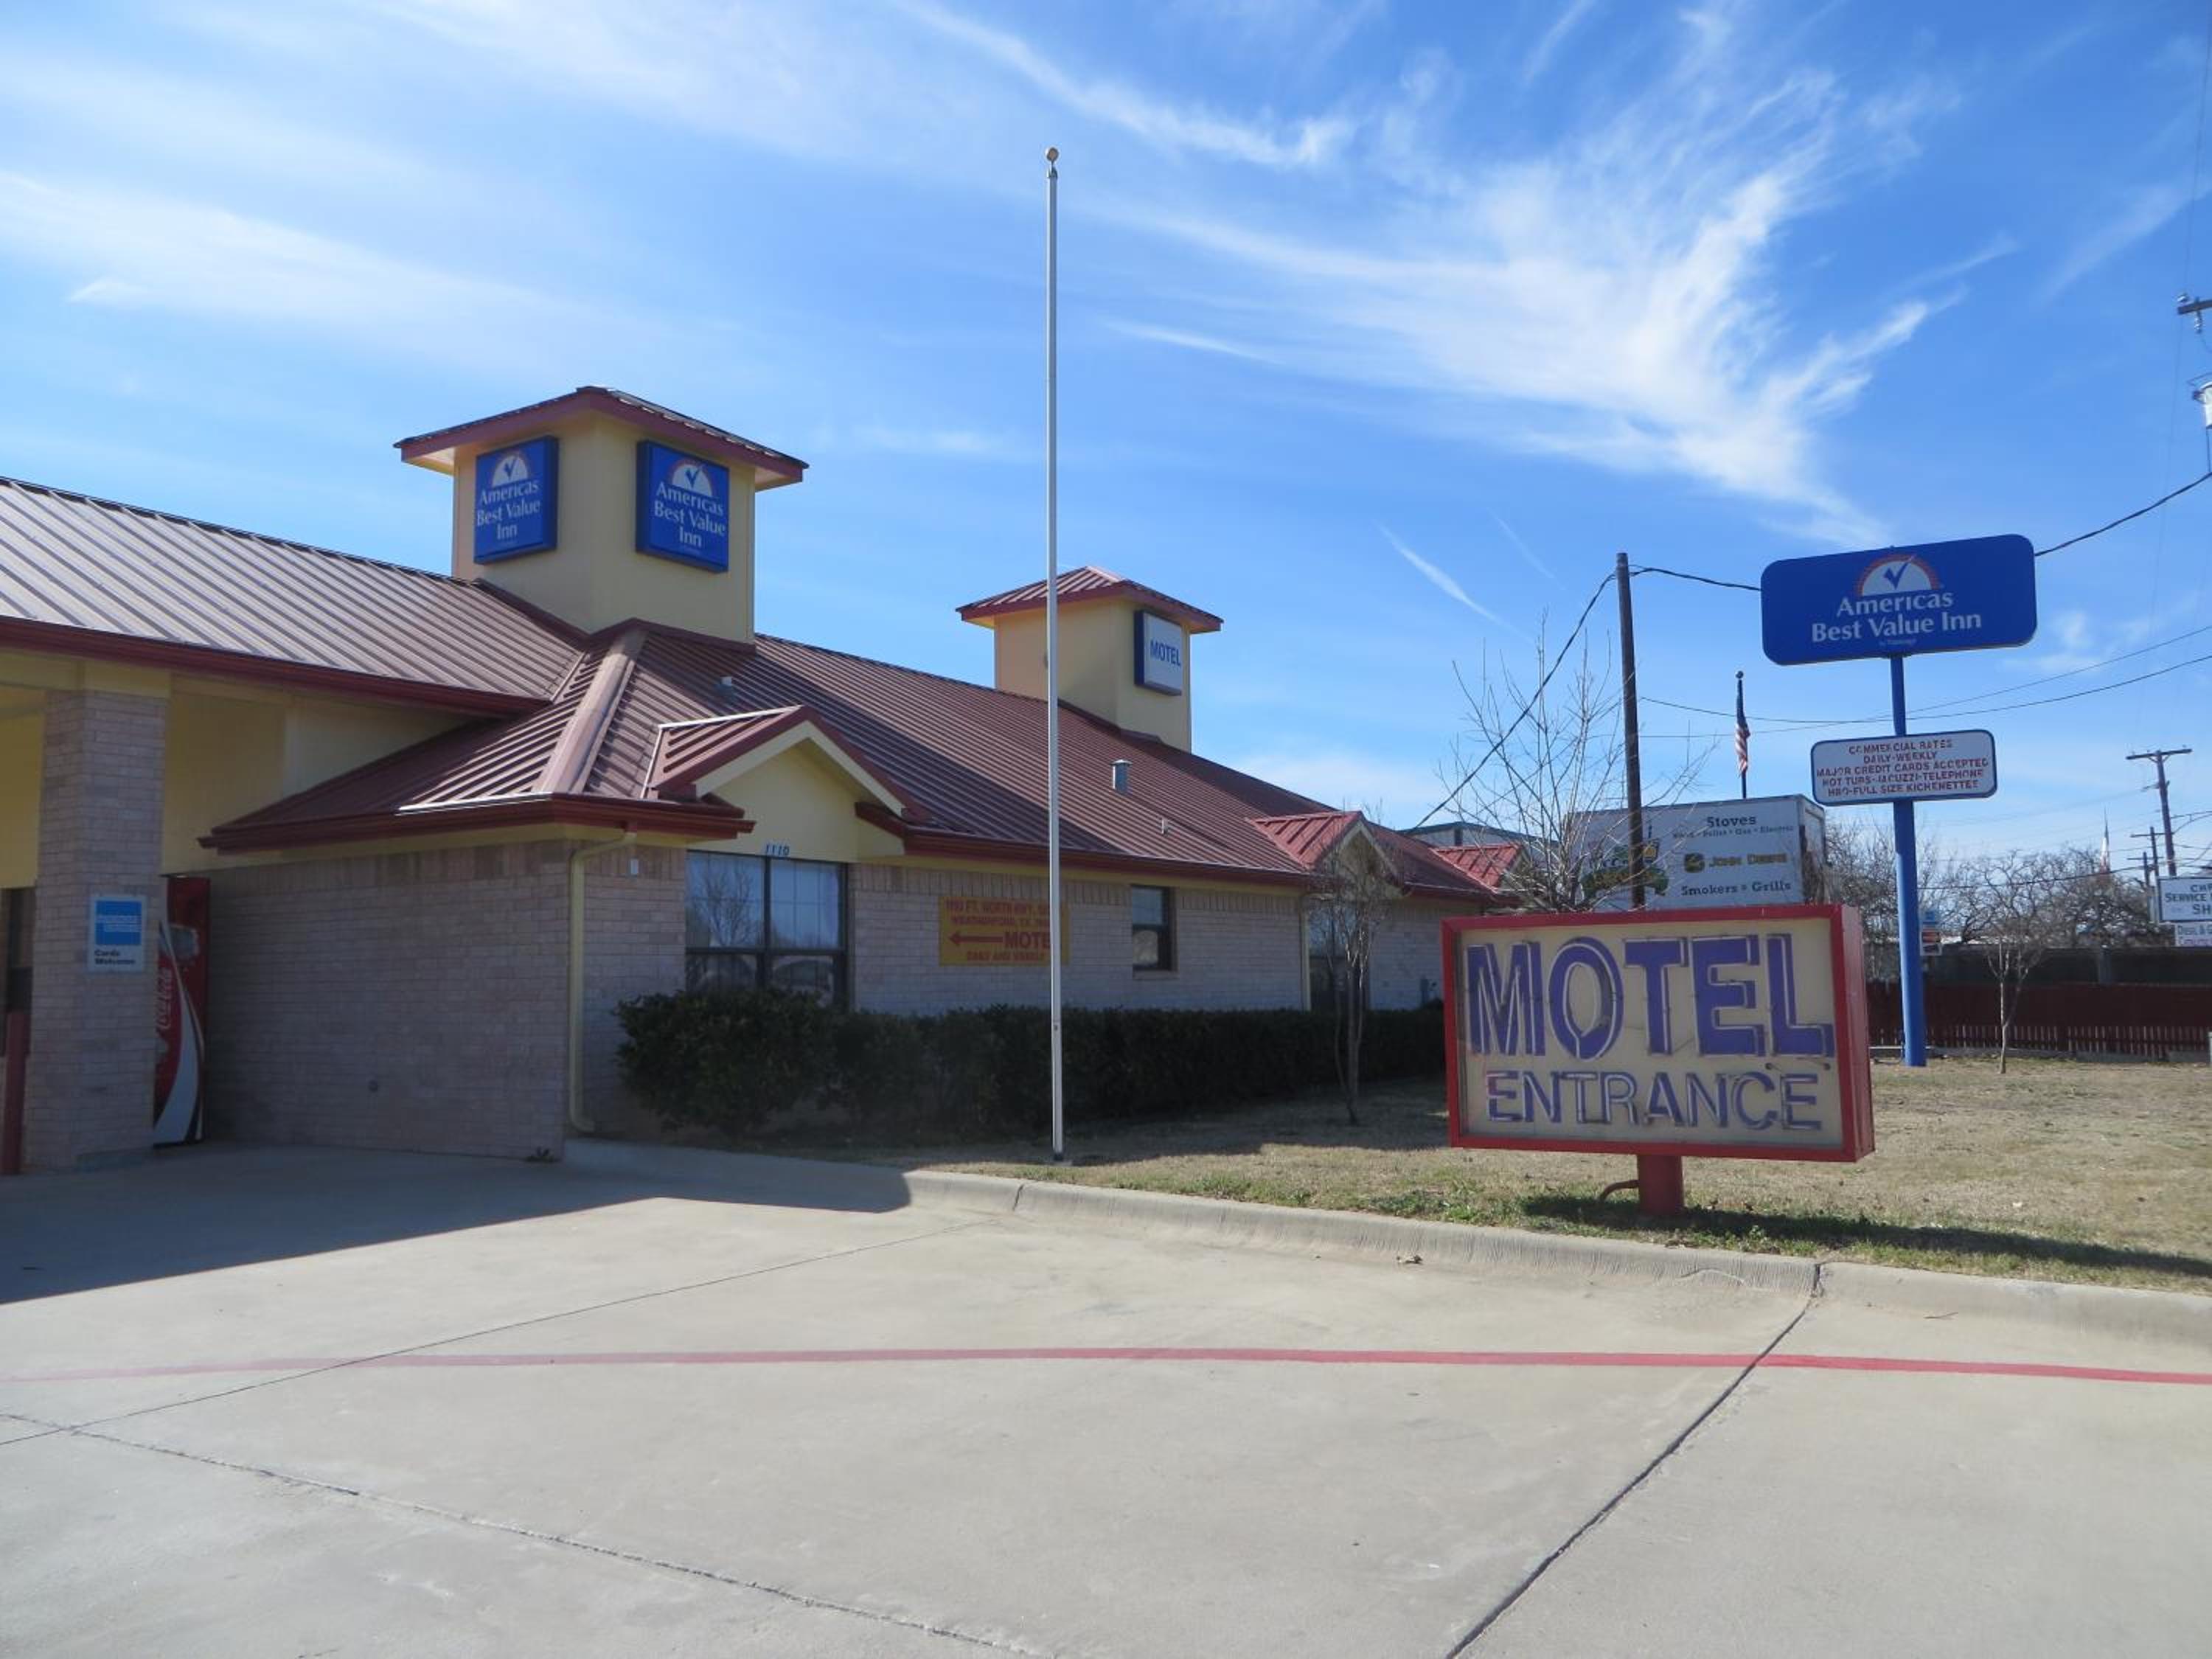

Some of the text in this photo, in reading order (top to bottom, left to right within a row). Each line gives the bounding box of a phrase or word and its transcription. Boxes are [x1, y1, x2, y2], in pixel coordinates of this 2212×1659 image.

[480, 479, 540, 506] Americas
[655, 482, 724, 516] Americas
[476, 498, 540, 527] Best Value
[654, 499, 726, 537] Best Value
[497, 524, 518, 540] Inn
[679, 526, 702, 548] Inn
[1836, 591, 1953, 618] Americas
[1812, 611, 1982, 643] Best Value Inn
[1150, 639, 1181, 667] MOTEL
[1894, 762, 1930, 772] CARDS
[1707, 816, 1756, 827] Stoves
[1681, 880, 1791, 897] Smokers Grills
[1004, 931, 1051, 949] MOTE
[1464, 933, 1835, 1060] MOTEL
[1485, 1070, 1823, 1131] ENTRANCE
